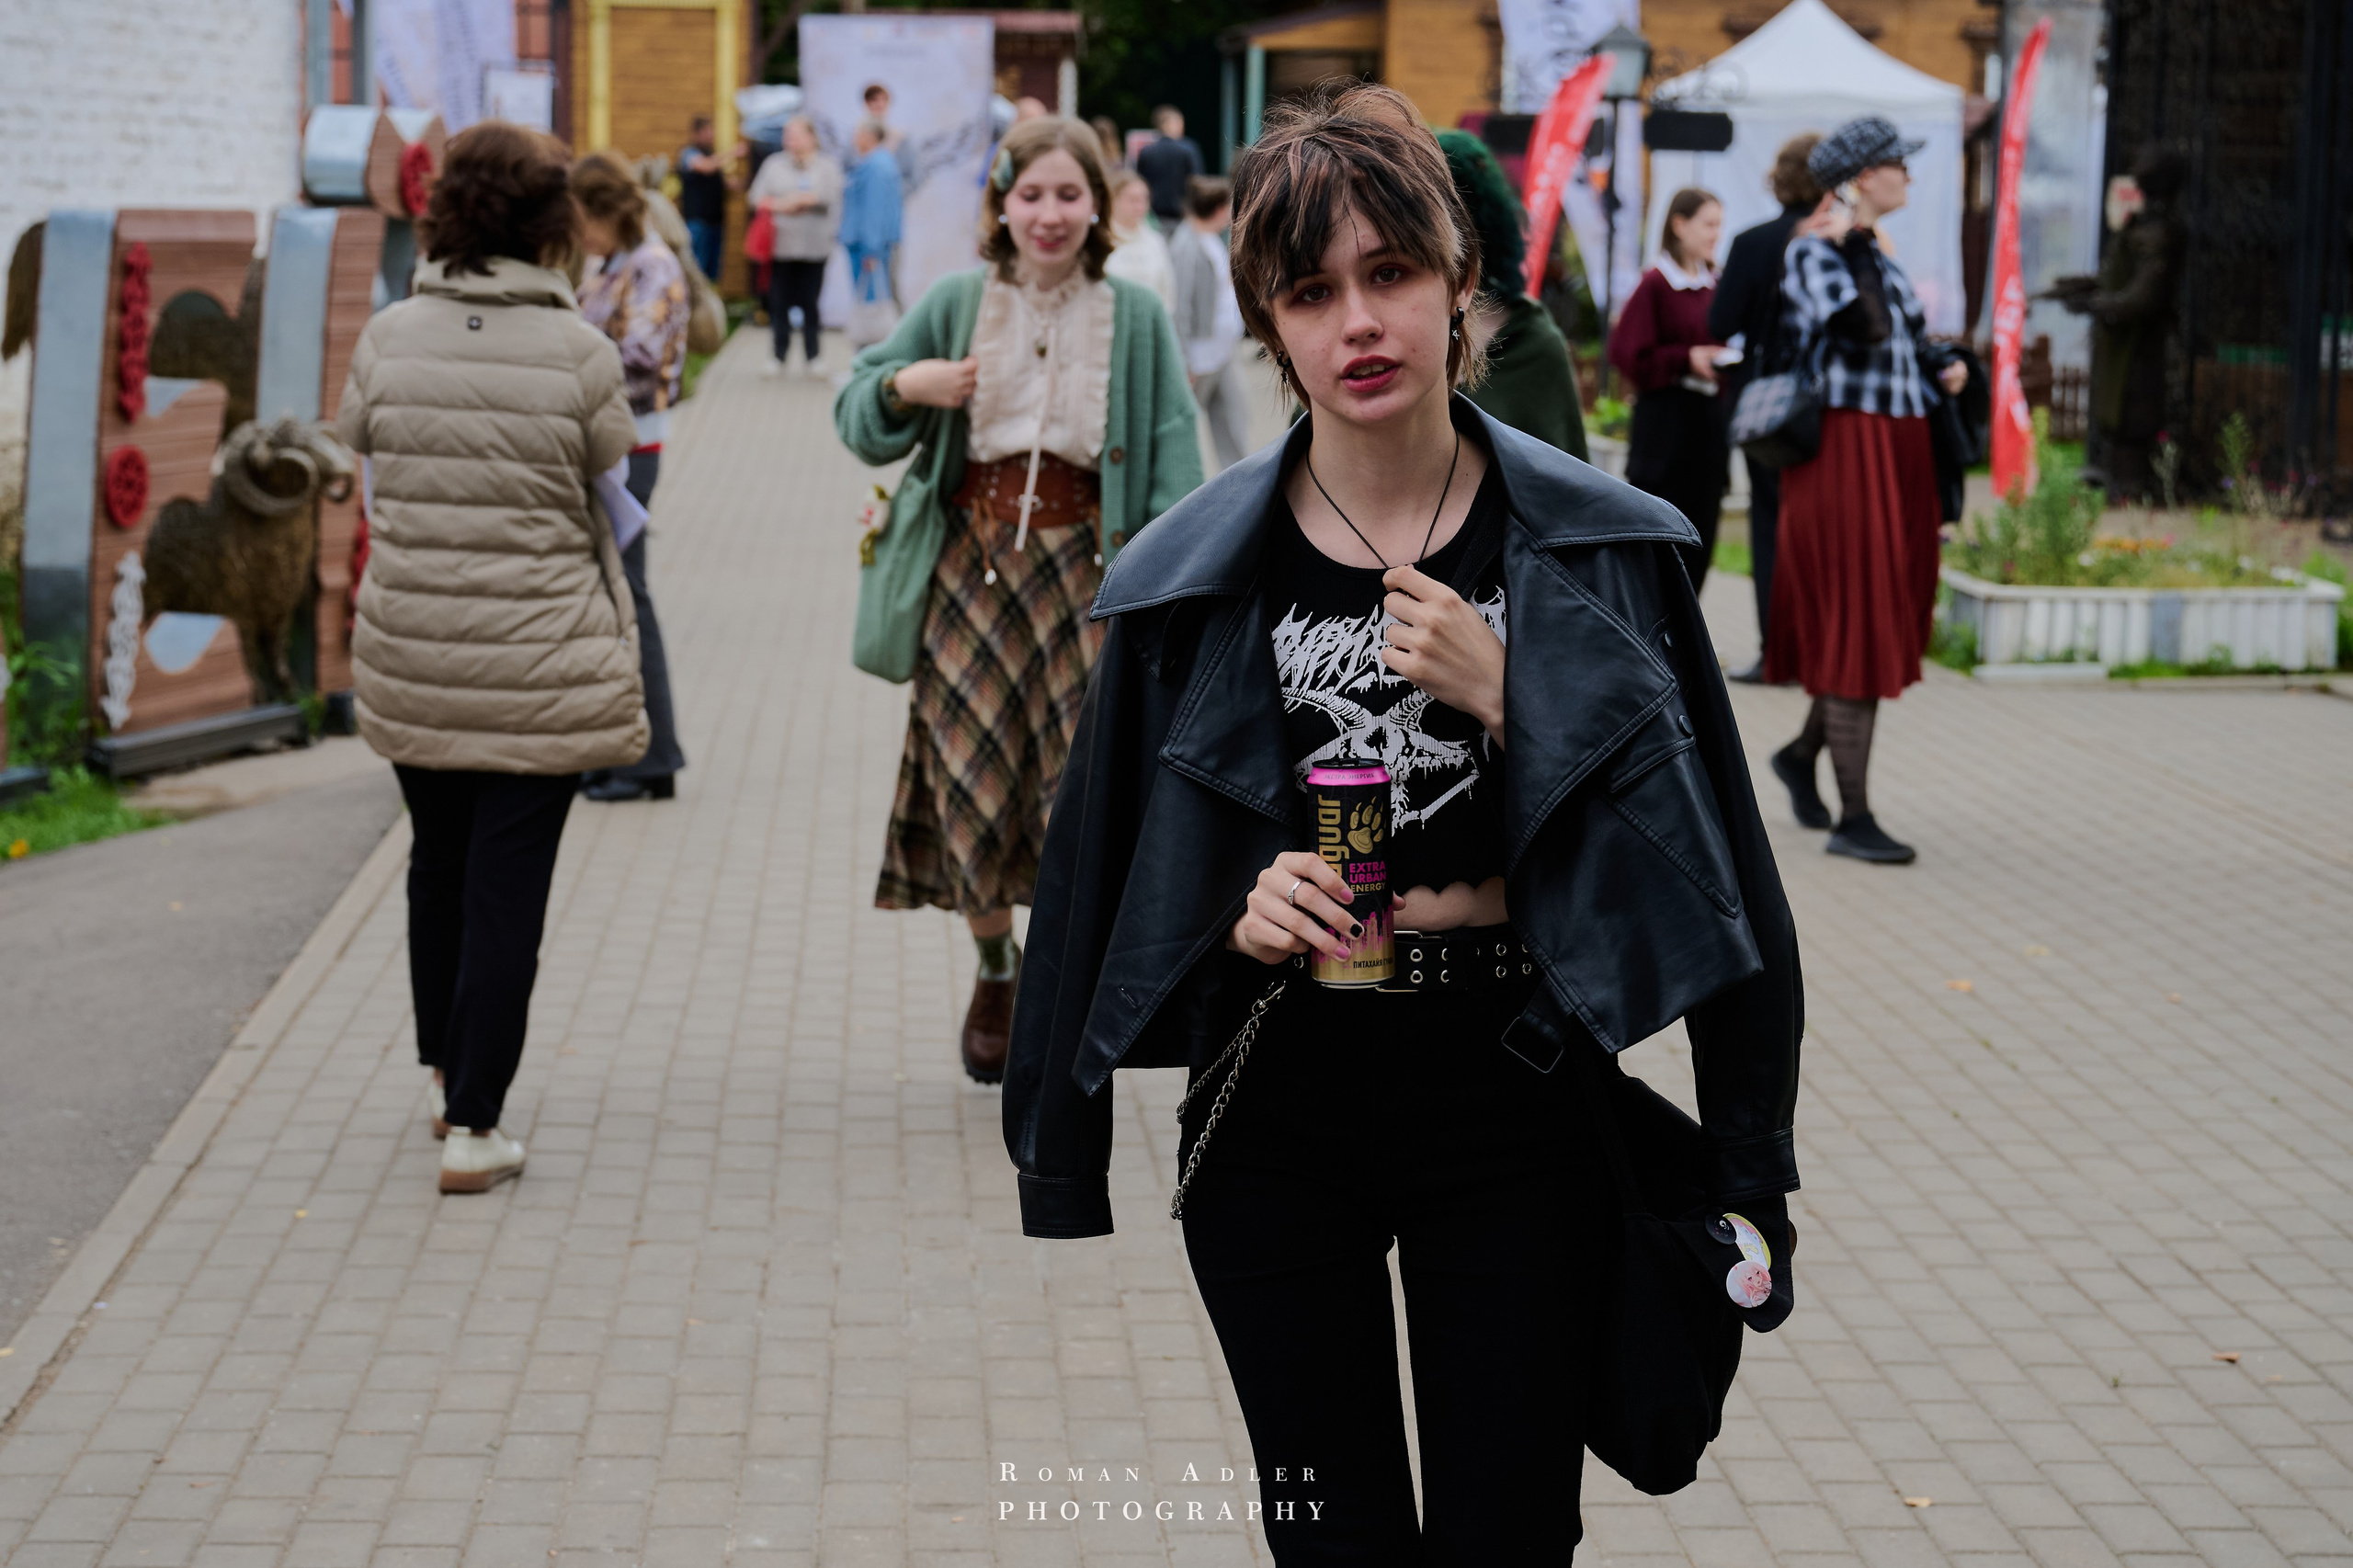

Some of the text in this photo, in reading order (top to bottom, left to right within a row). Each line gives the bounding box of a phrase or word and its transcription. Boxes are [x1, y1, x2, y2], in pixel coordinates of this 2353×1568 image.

[1349, 860, 1386, 874] EXTRA
[1349, 871, 1387, 884] URBAN
[1350, 882, 1386, 892] ENERGY
